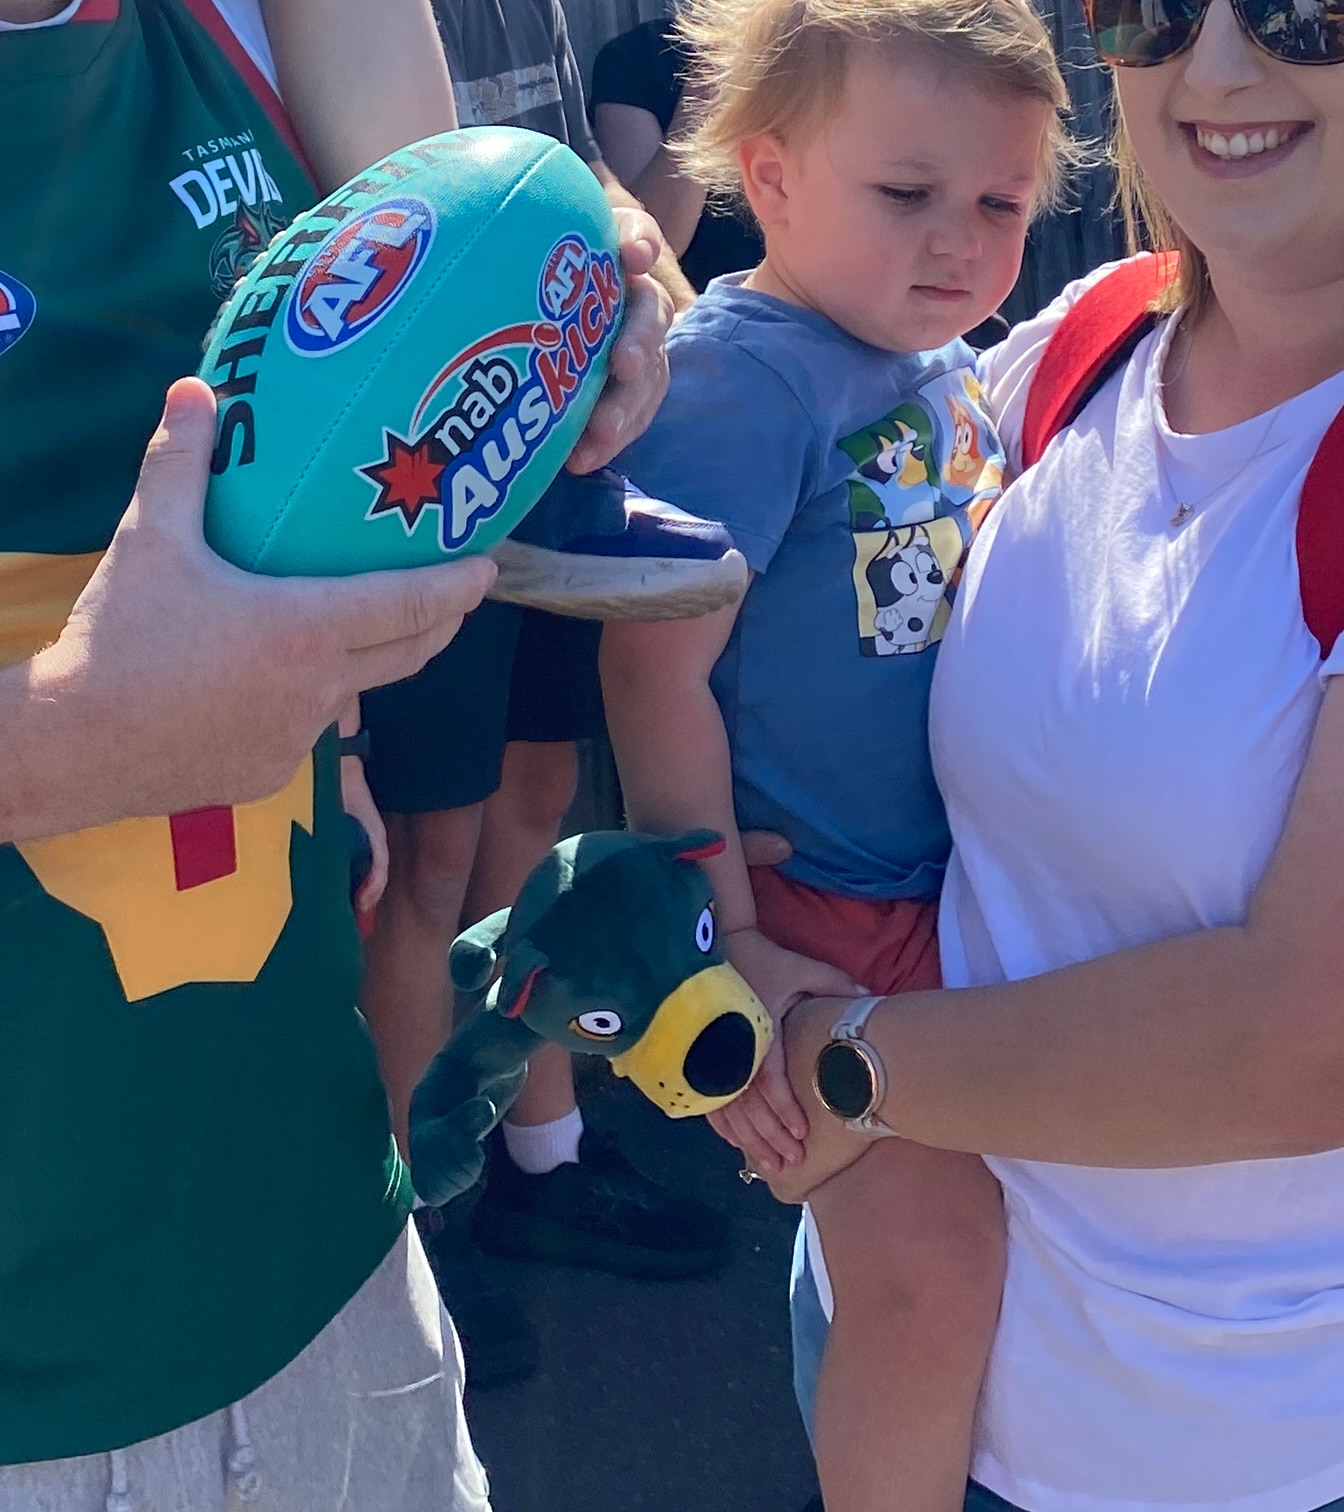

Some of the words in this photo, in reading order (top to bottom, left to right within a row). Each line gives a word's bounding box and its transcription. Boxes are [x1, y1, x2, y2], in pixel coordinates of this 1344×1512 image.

[302, 211, 427, 341] AFL
[546, 245, 587, 319] AFL
[435, 361, 514, 456] nab
